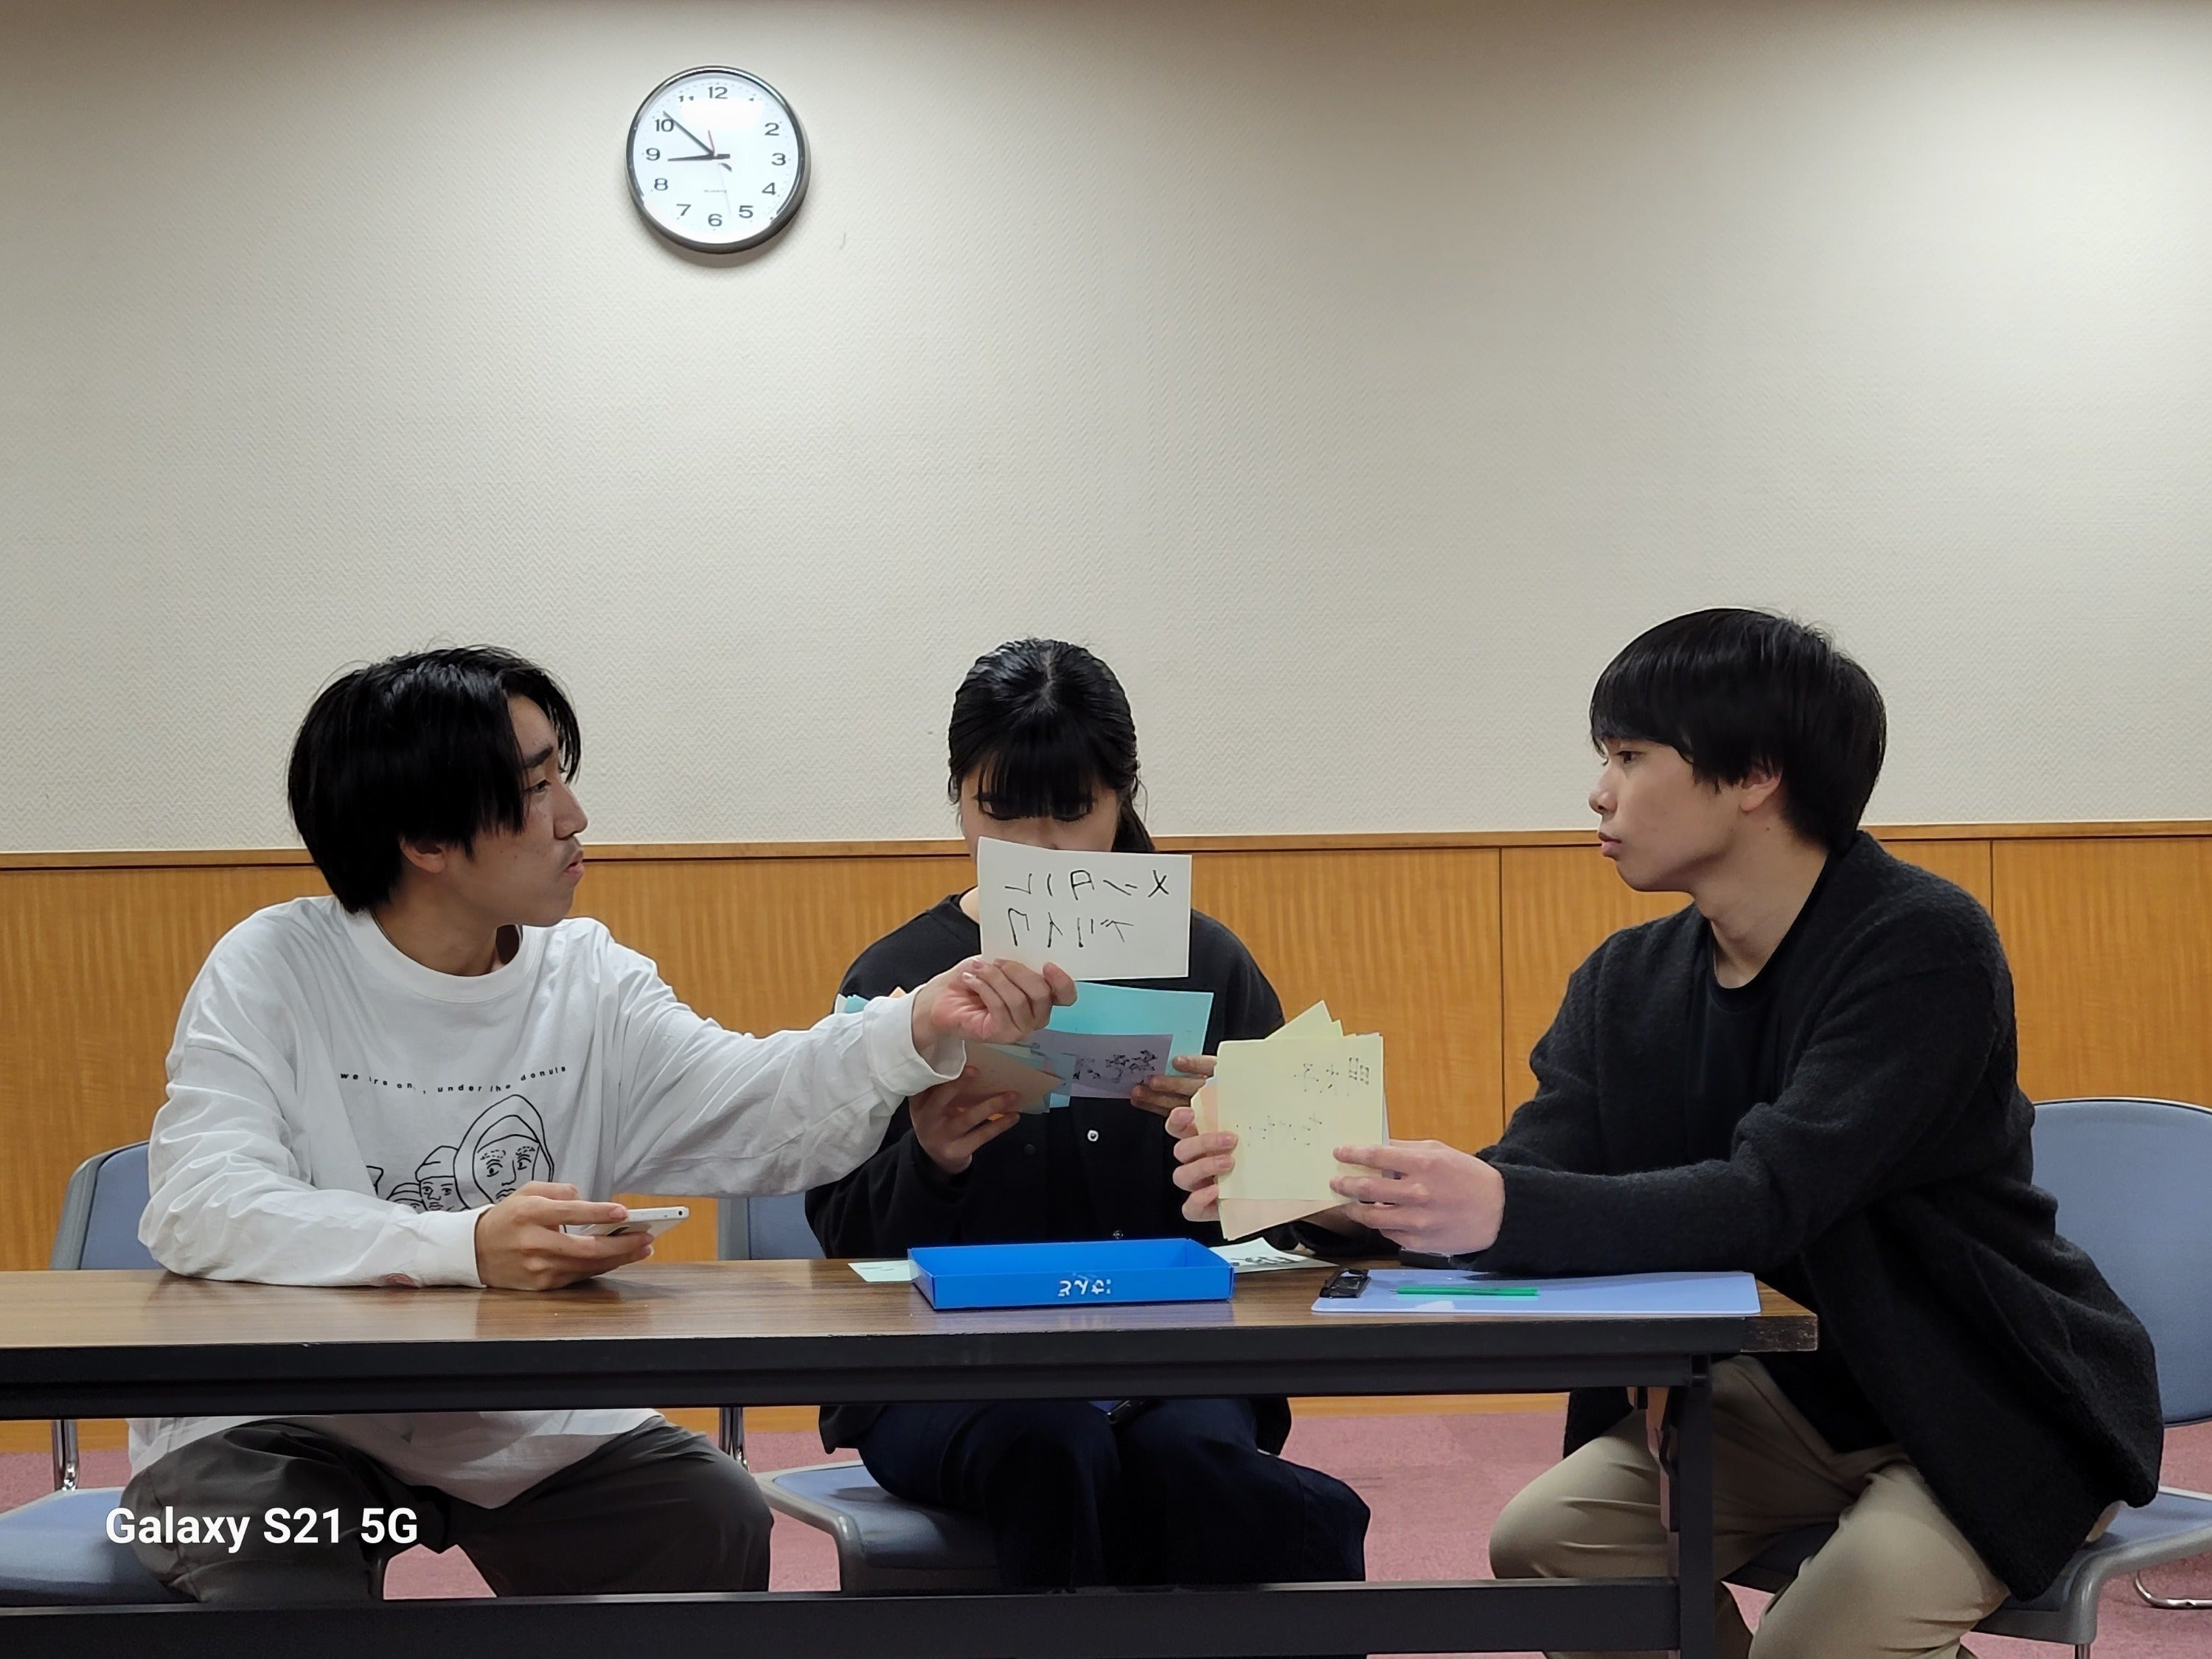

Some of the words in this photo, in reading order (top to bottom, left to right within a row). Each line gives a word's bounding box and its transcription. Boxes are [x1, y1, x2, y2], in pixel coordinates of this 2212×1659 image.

[708, 86, 728, 99] 12
[655, 118, 674, 132] 10
[765, 122, 779, 136] 2
[646, 147, 661, 161] 9
[771, 153, 786, 166] 3
[653, 178, 669, 191] 8
[762, 182, 776, 195] 4
[676, 204, 692, 217] 7
[738, 205, 754, 219] 5
[708, 213, 723, 227] 6
[437, 1084, 481, 1092] under
[521, 1066, 566, 1081] donuts
